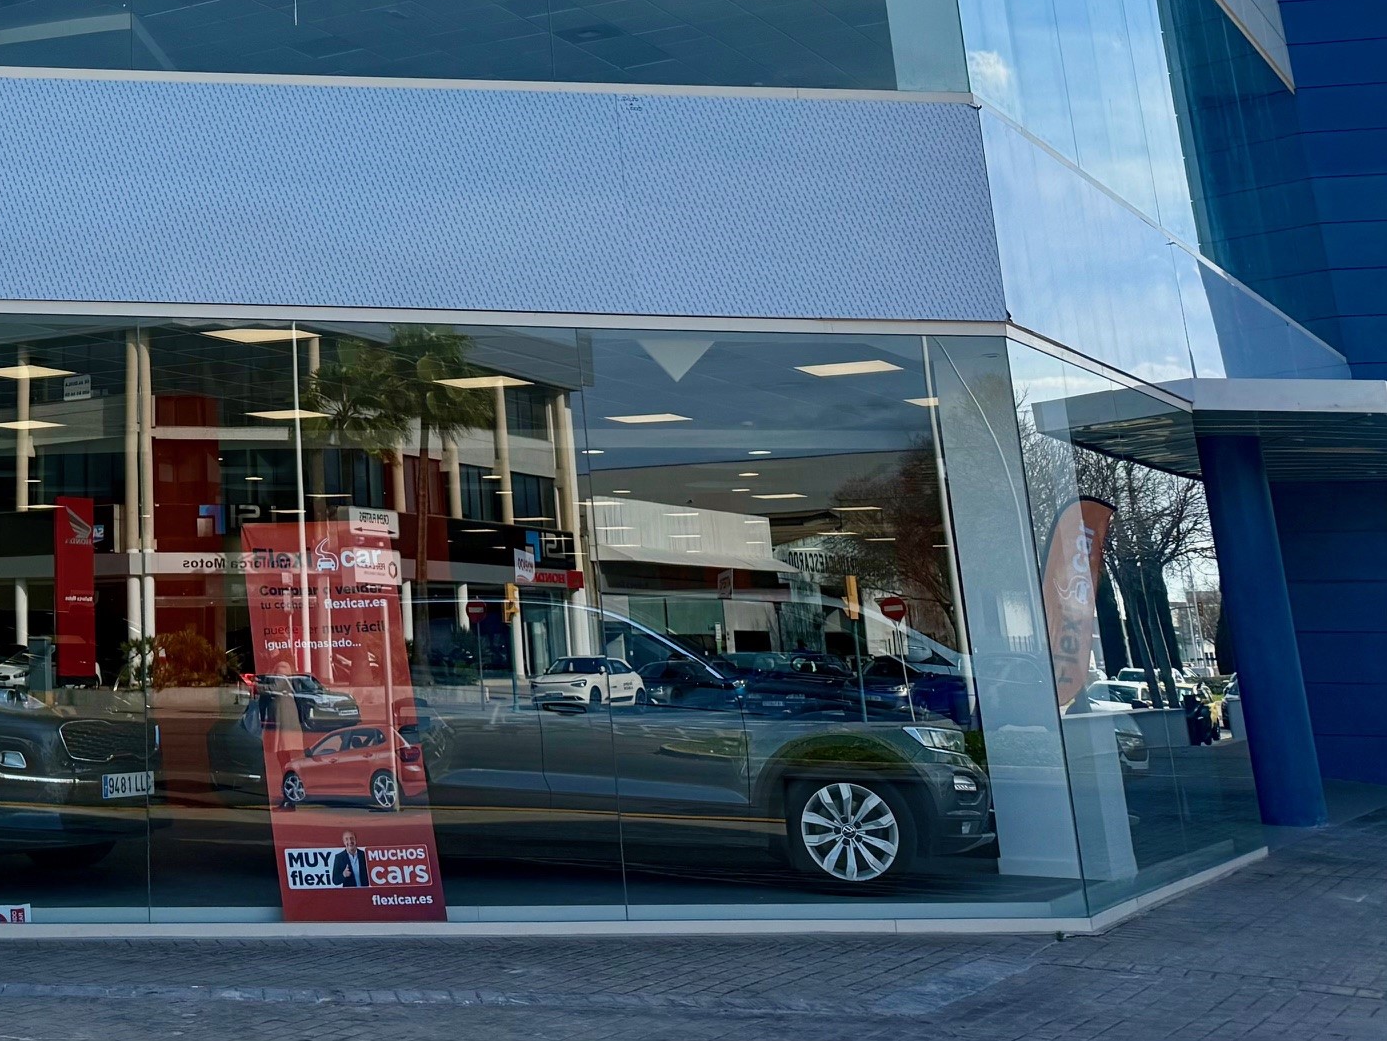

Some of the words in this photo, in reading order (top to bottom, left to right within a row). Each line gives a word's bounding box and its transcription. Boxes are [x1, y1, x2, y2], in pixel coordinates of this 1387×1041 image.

[1072, 519, 1095, 573] car
[341, 550, 381, 568] car
[335, 583, 383, 595] vender
[260, 601, 271, 610] tu
[323, 598, 387, 610] flexicar.es
[322, 624, 351, 636] muy
[108, 775, 133, 795] 9481
[288, 851, 332, 869] MUY
[368, 848, 426, 862] MUCHOS
[291, 870, 332, 887] flexi
[371, 864, 430, 886] cars
[371, 894, 434, 906] flexicar.es
